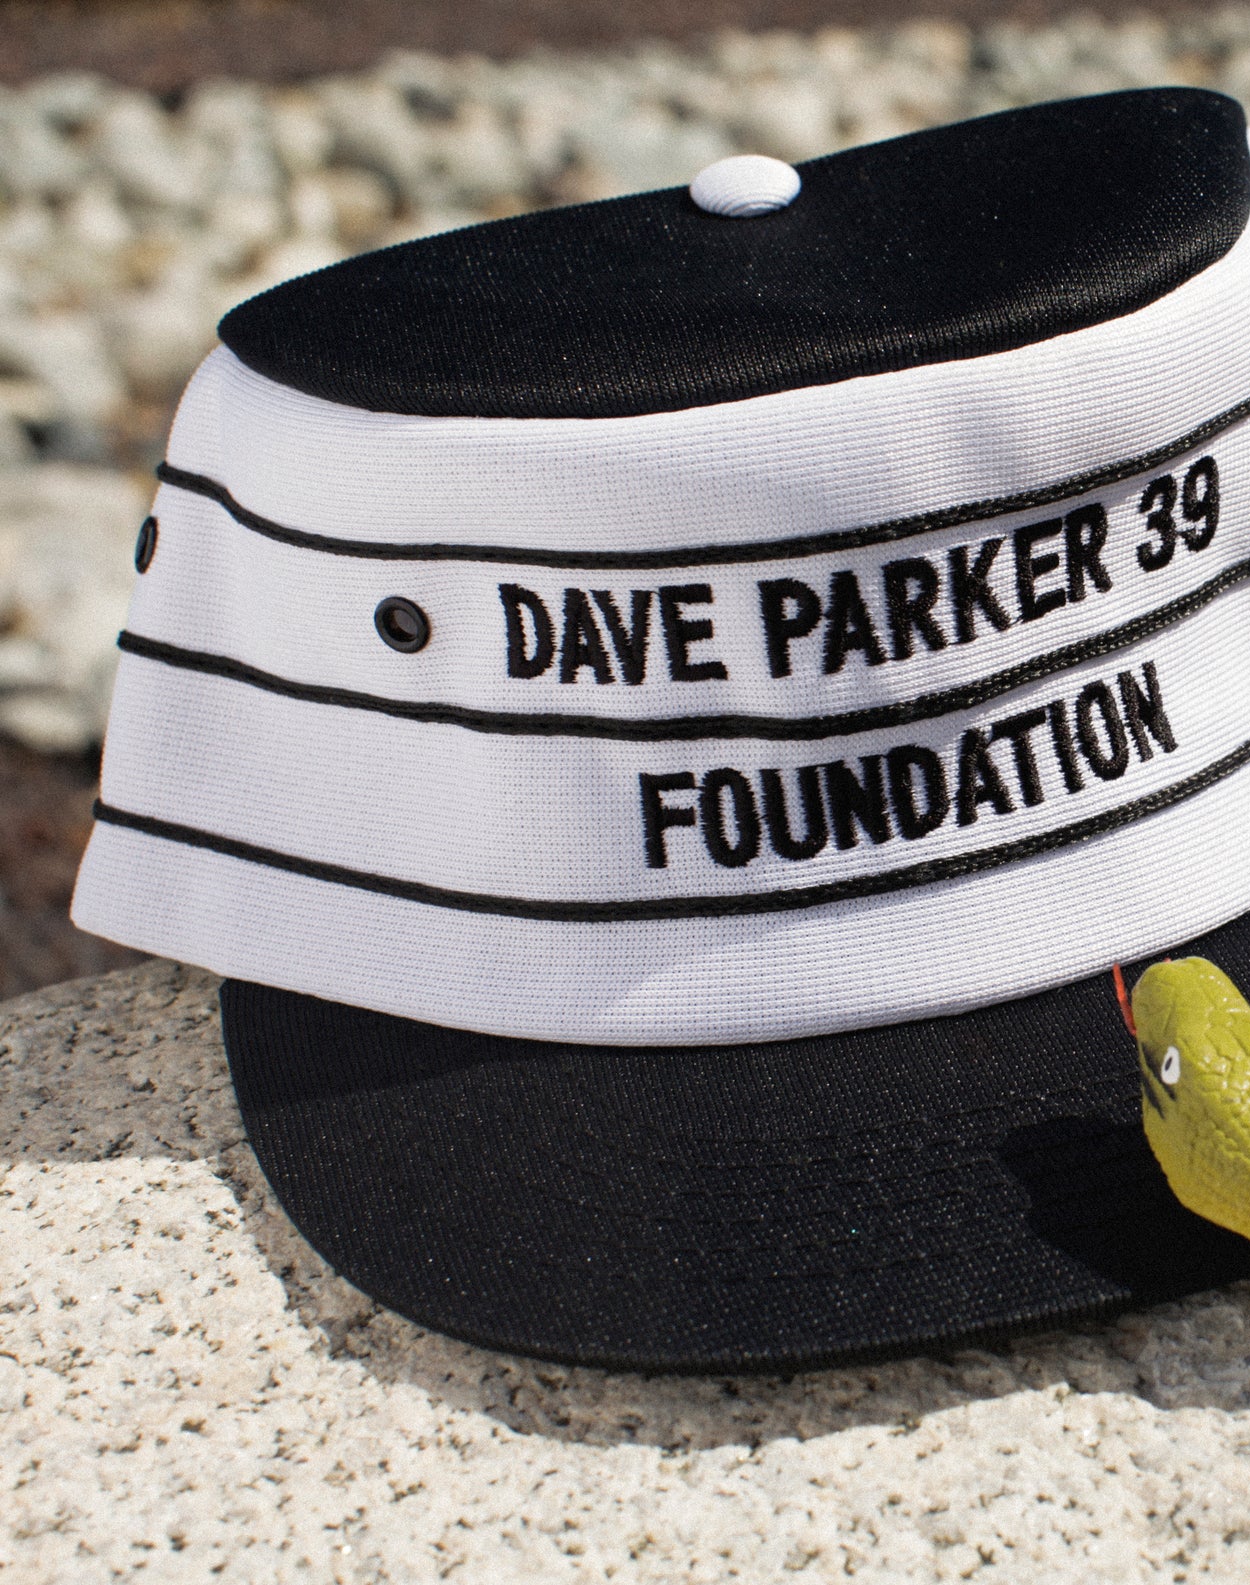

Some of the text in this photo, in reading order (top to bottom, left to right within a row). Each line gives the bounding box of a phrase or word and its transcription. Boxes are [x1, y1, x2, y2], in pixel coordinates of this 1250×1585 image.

[498, 455, 1221, 686] DAVE PARKER 39
[638, 660, 1178, 870] FOUNDATION
